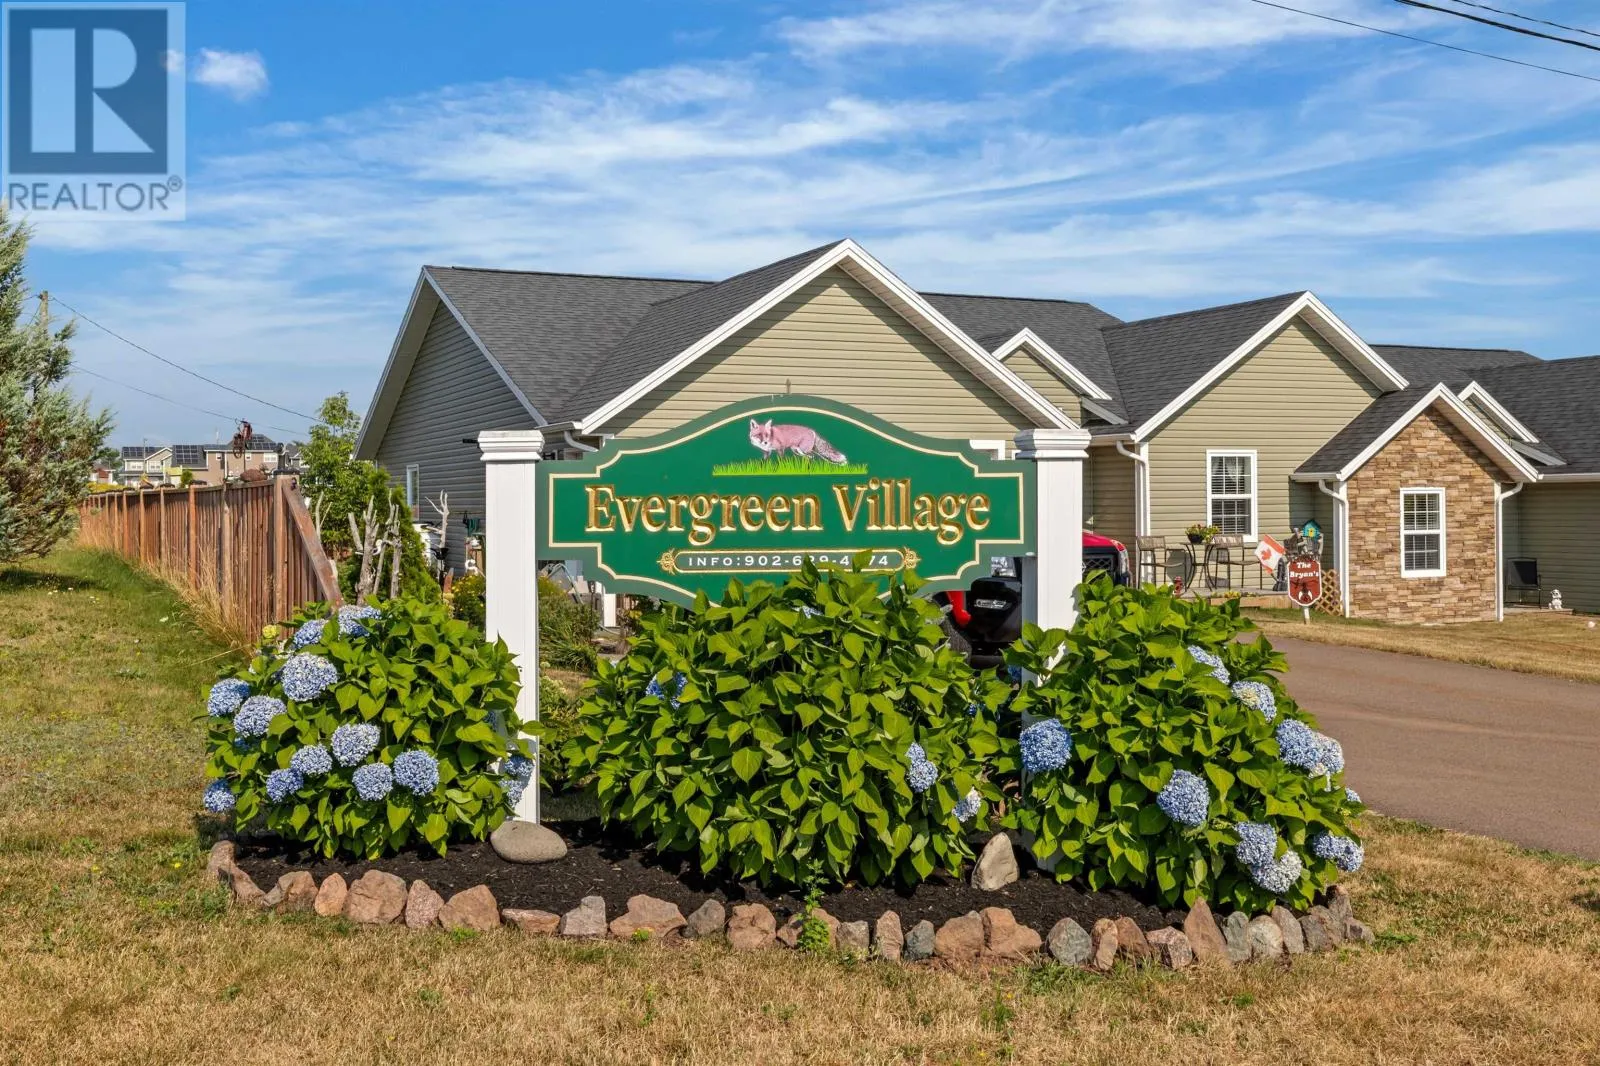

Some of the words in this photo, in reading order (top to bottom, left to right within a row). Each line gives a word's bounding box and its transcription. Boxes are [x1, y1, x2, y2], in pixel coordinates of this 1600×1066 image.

[584, 484, 824, 546] Evergreen
[832, 477, 990, 545] Village
[688, 555, 889, 566] INFO:902-629-474
